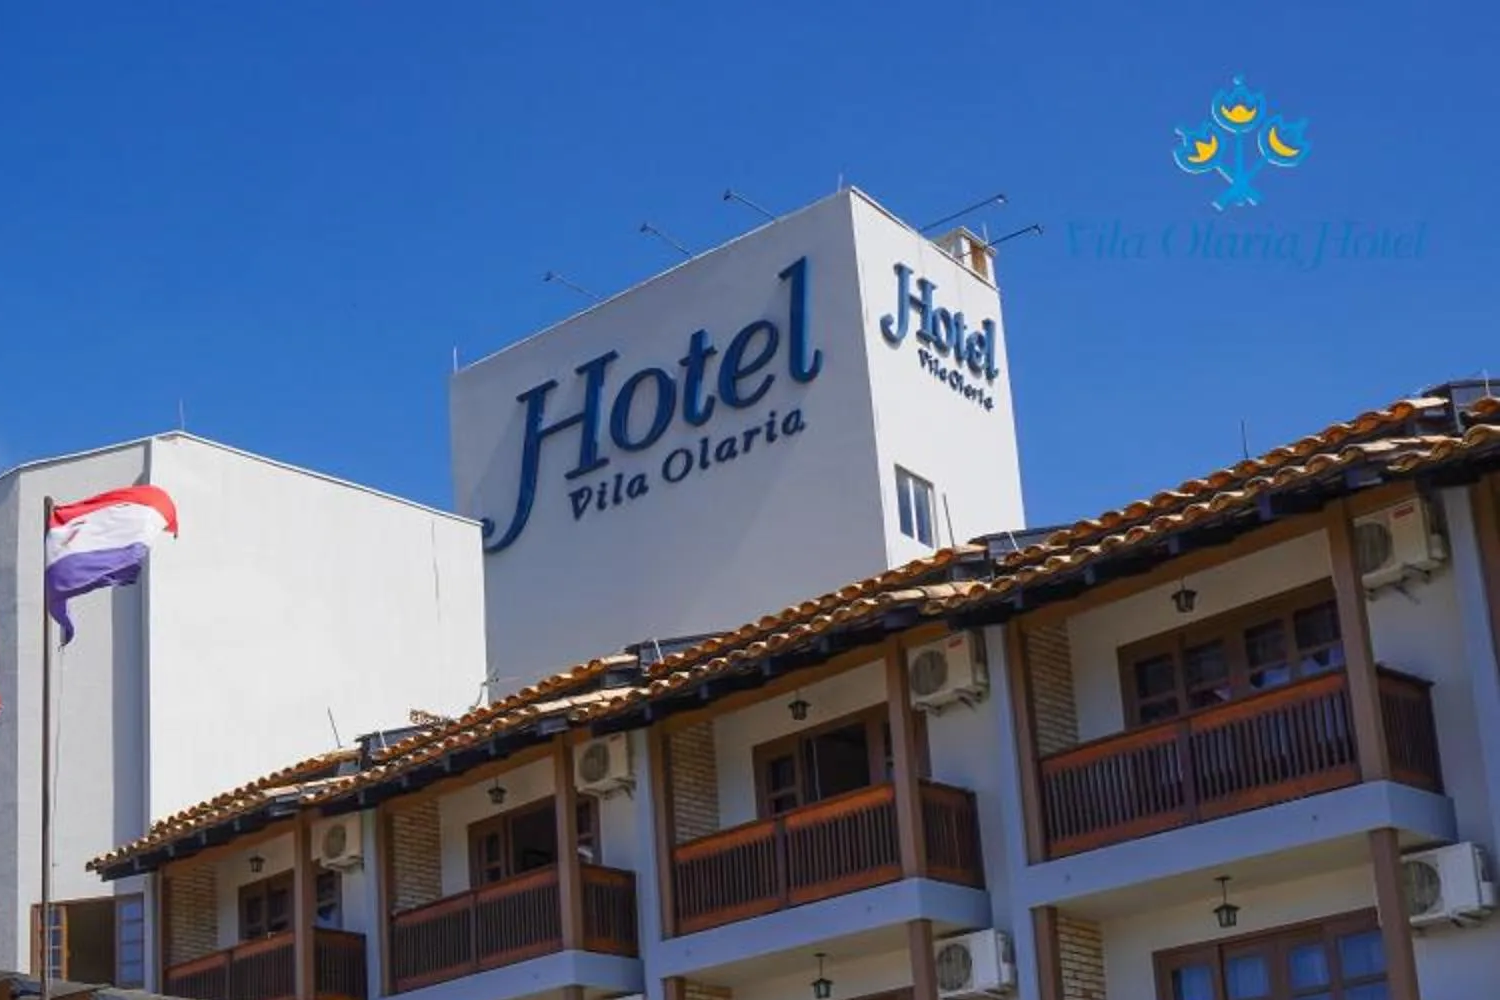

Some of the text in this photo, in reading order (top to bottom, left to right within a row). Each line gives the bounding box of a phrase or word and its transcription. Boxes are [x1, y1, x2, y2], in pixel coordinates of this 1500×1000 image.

[880, 262, 999, 381] Hotel
[479, 255, 823, 554] Hotel
[917, 348, 994, 411] Vila Olaria
[567, 409, 807, 521] Vila Olaria
